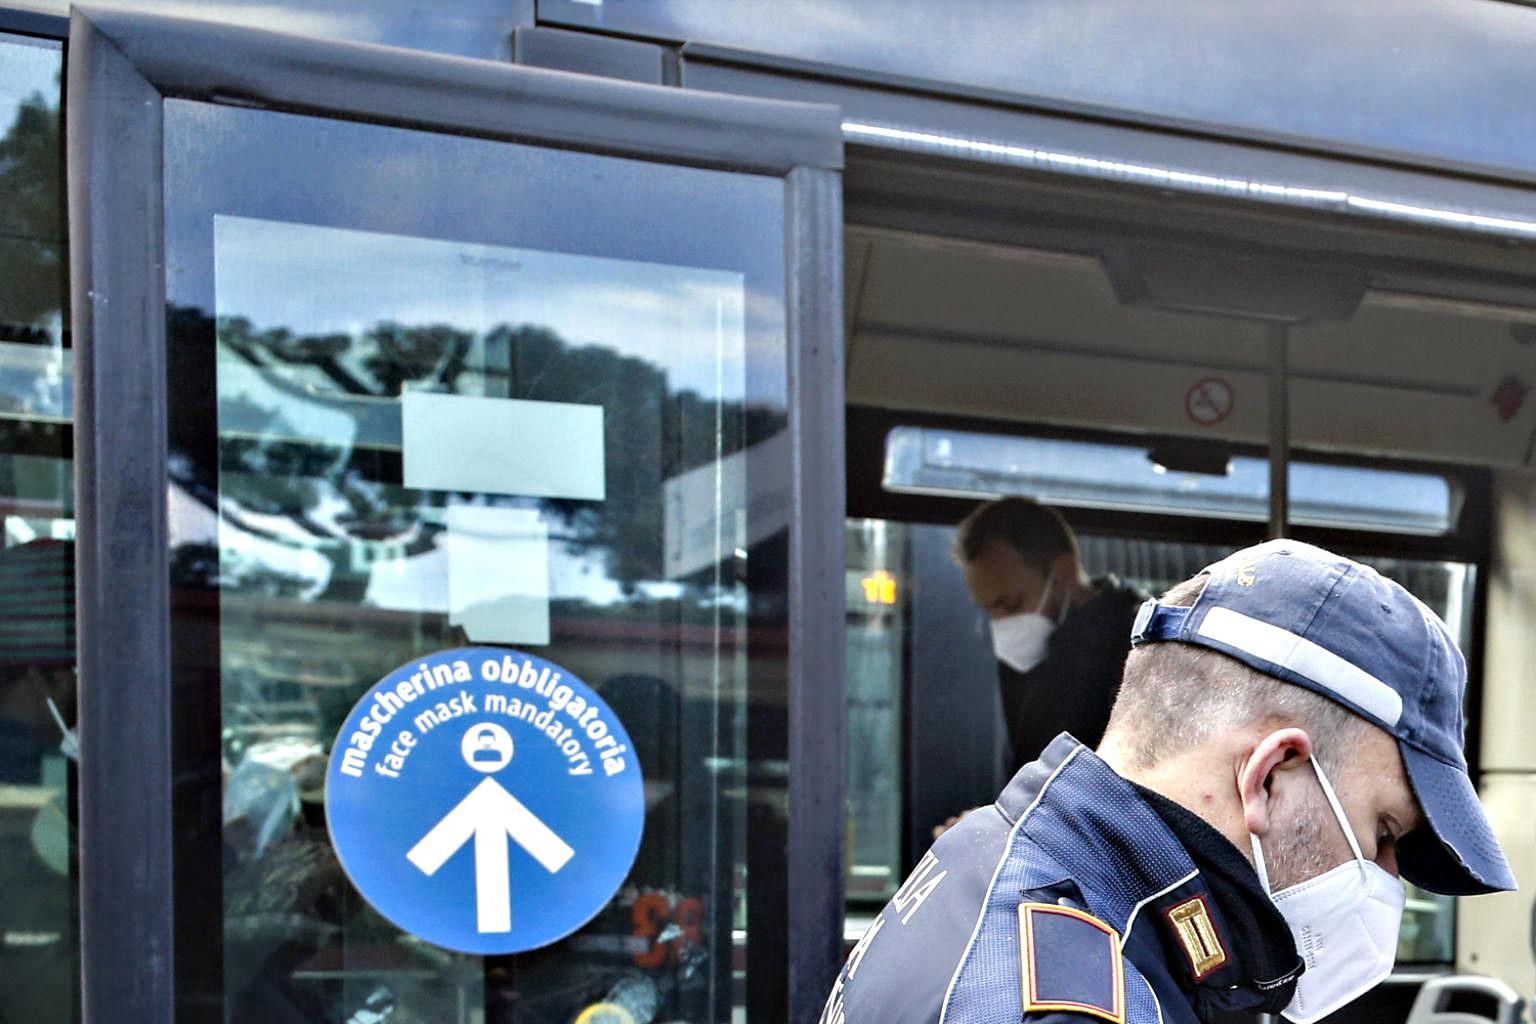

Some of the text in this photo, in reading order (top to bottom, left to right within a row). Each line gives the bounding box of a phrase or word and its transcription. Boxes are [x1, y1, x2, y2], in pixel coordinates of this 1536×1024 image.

[340, 655, 627, 777] mascherina obbligatoria
[375, 690, 593, 778] face mask mandatory
